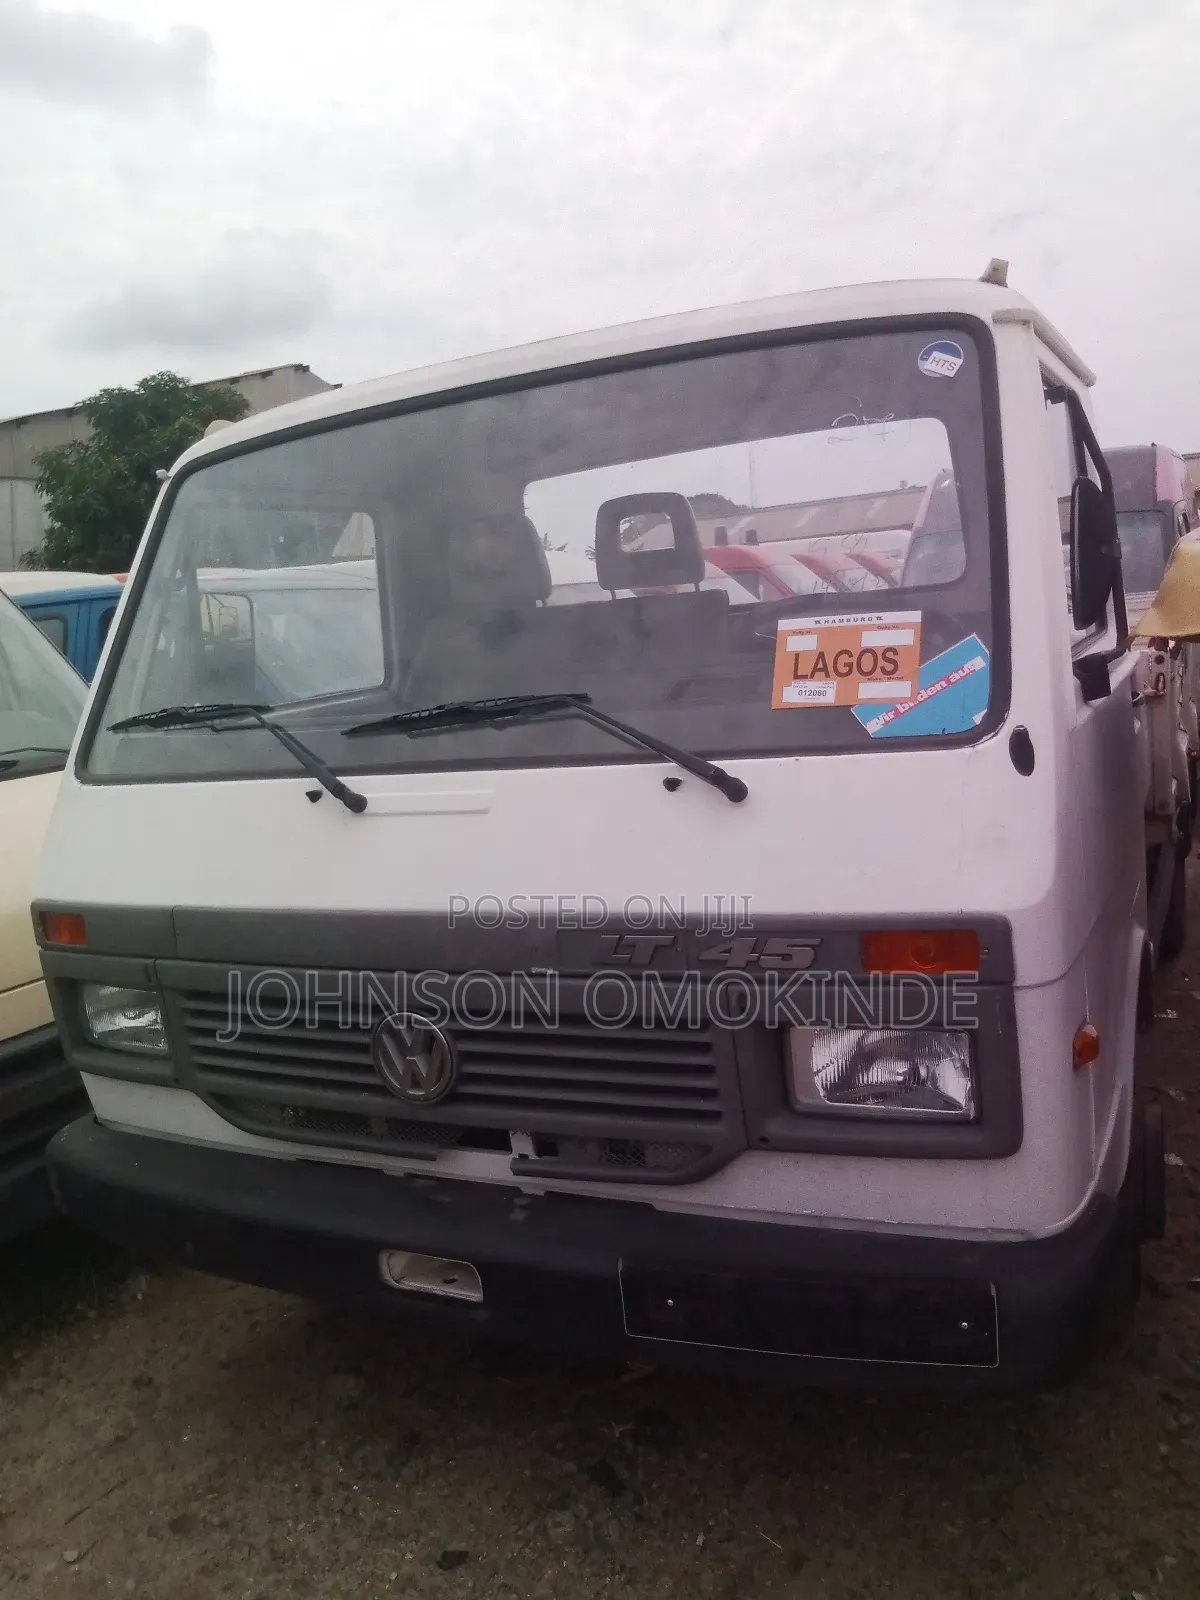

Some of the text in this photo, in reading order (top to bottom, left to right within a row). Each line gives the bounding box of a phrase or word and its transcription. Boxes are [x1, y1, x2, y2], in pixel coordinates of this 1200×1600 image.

[930, 356, 957, 371] HTS
[823, 616, 874, 626] HAMBURG
[792, 647, 900, 680] LAGOS
[797, 689, 828, 697] 012080
[597, 934, 823, 969] LT 45
